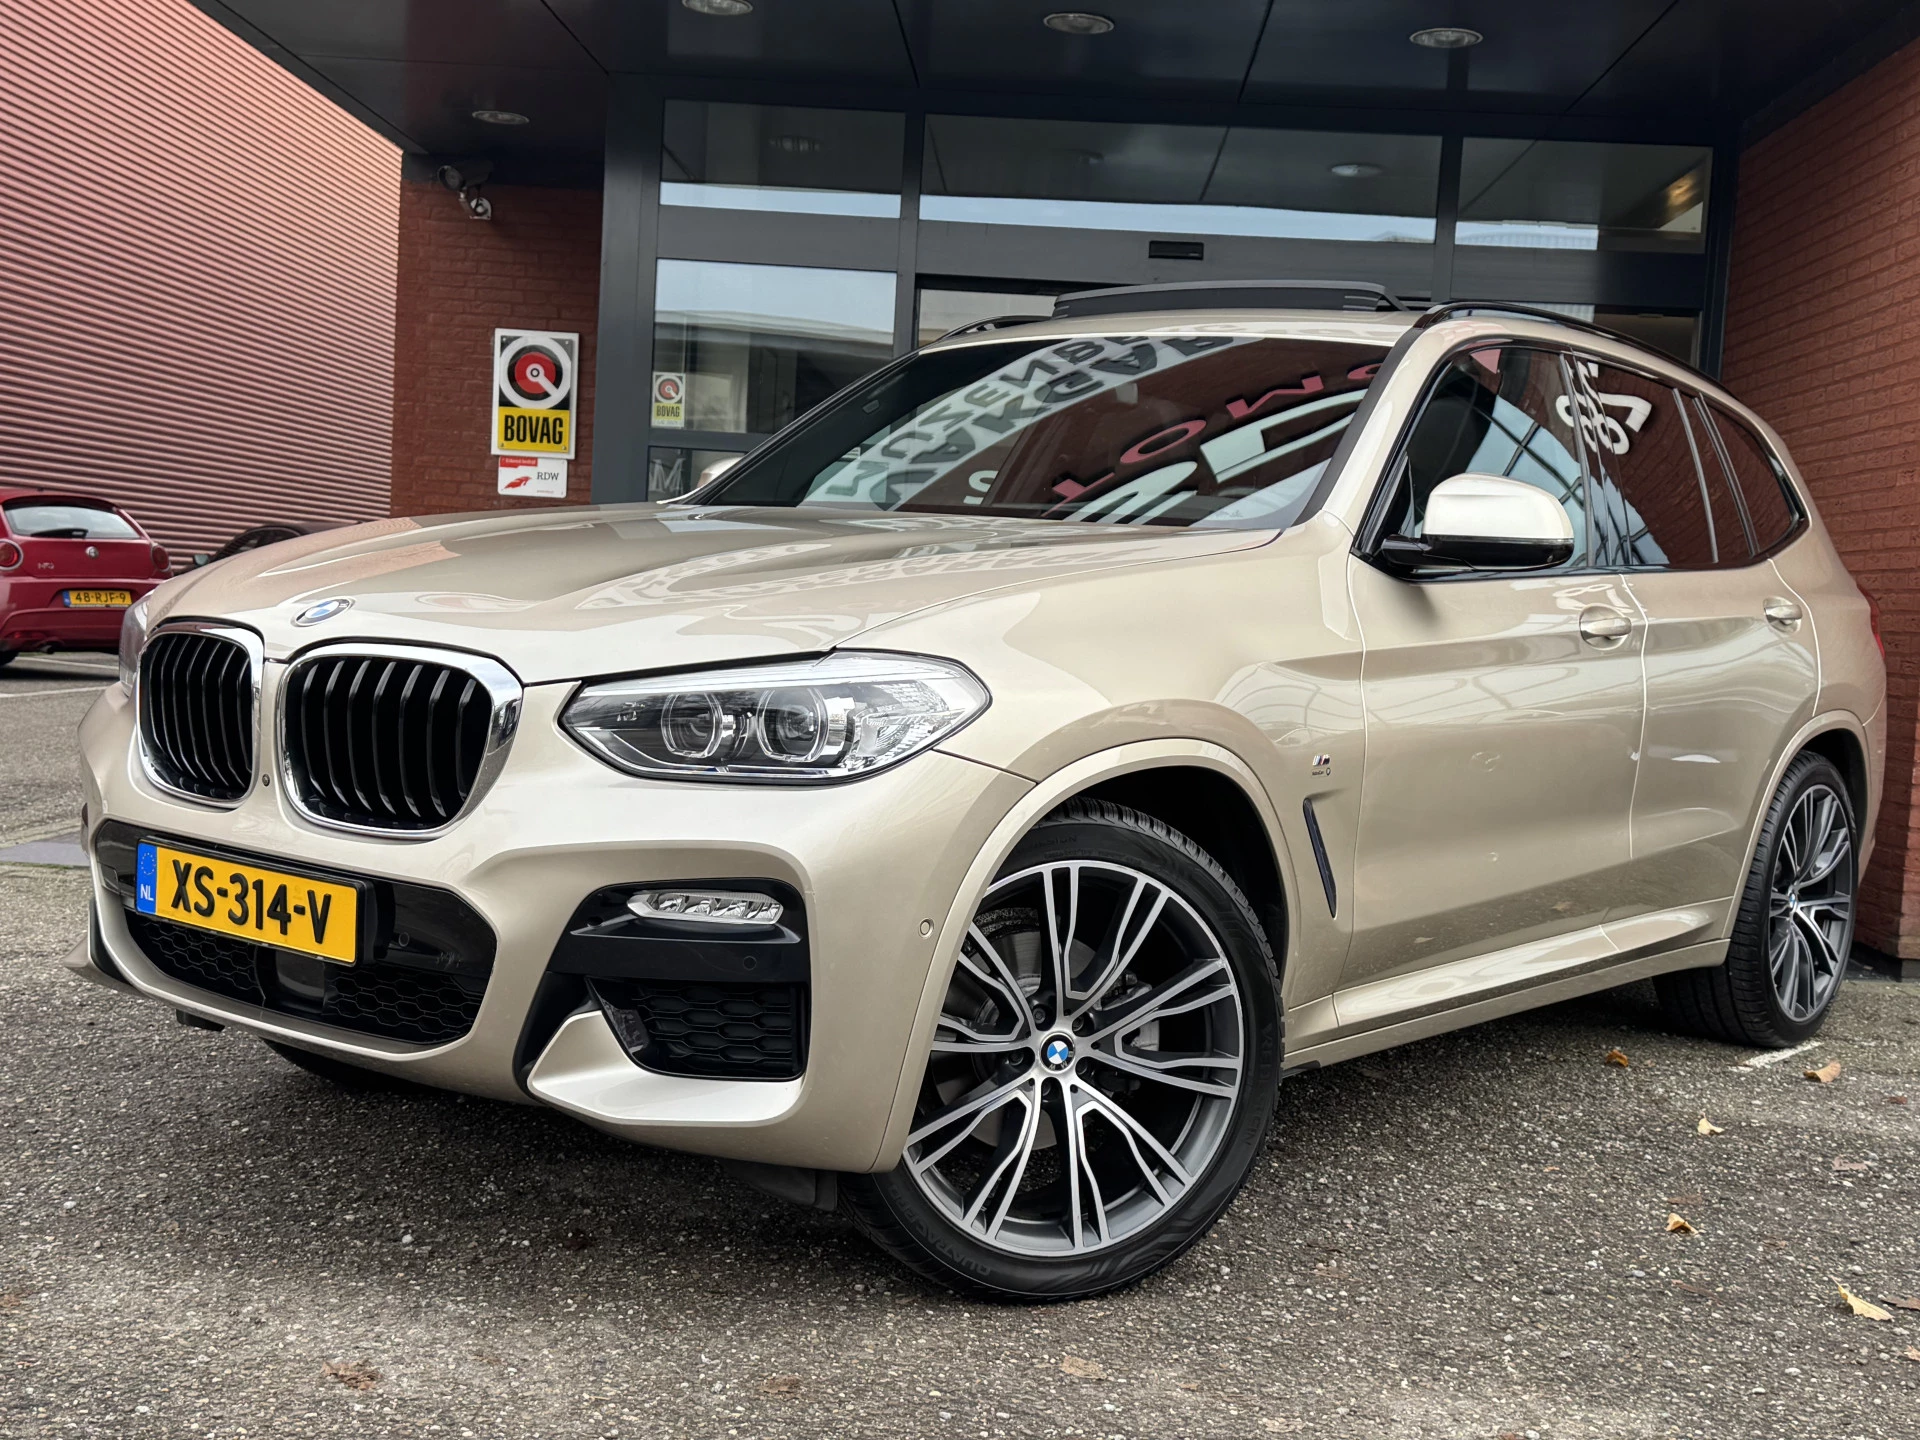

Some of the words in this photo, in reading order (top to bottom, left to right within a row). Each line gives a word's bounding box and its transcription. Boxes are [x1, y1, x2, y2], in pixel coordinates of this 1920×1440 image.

[656, 405, 680, 417] BOVAG
[504, 414, 564, 445] BOVAG
[536, 472, 559, 480] RDW
[75, 592, 126, 603] 48-RJF-9
[139, 883, 154, 901] NL
[171, 858, 332, 945] XS-314-V
